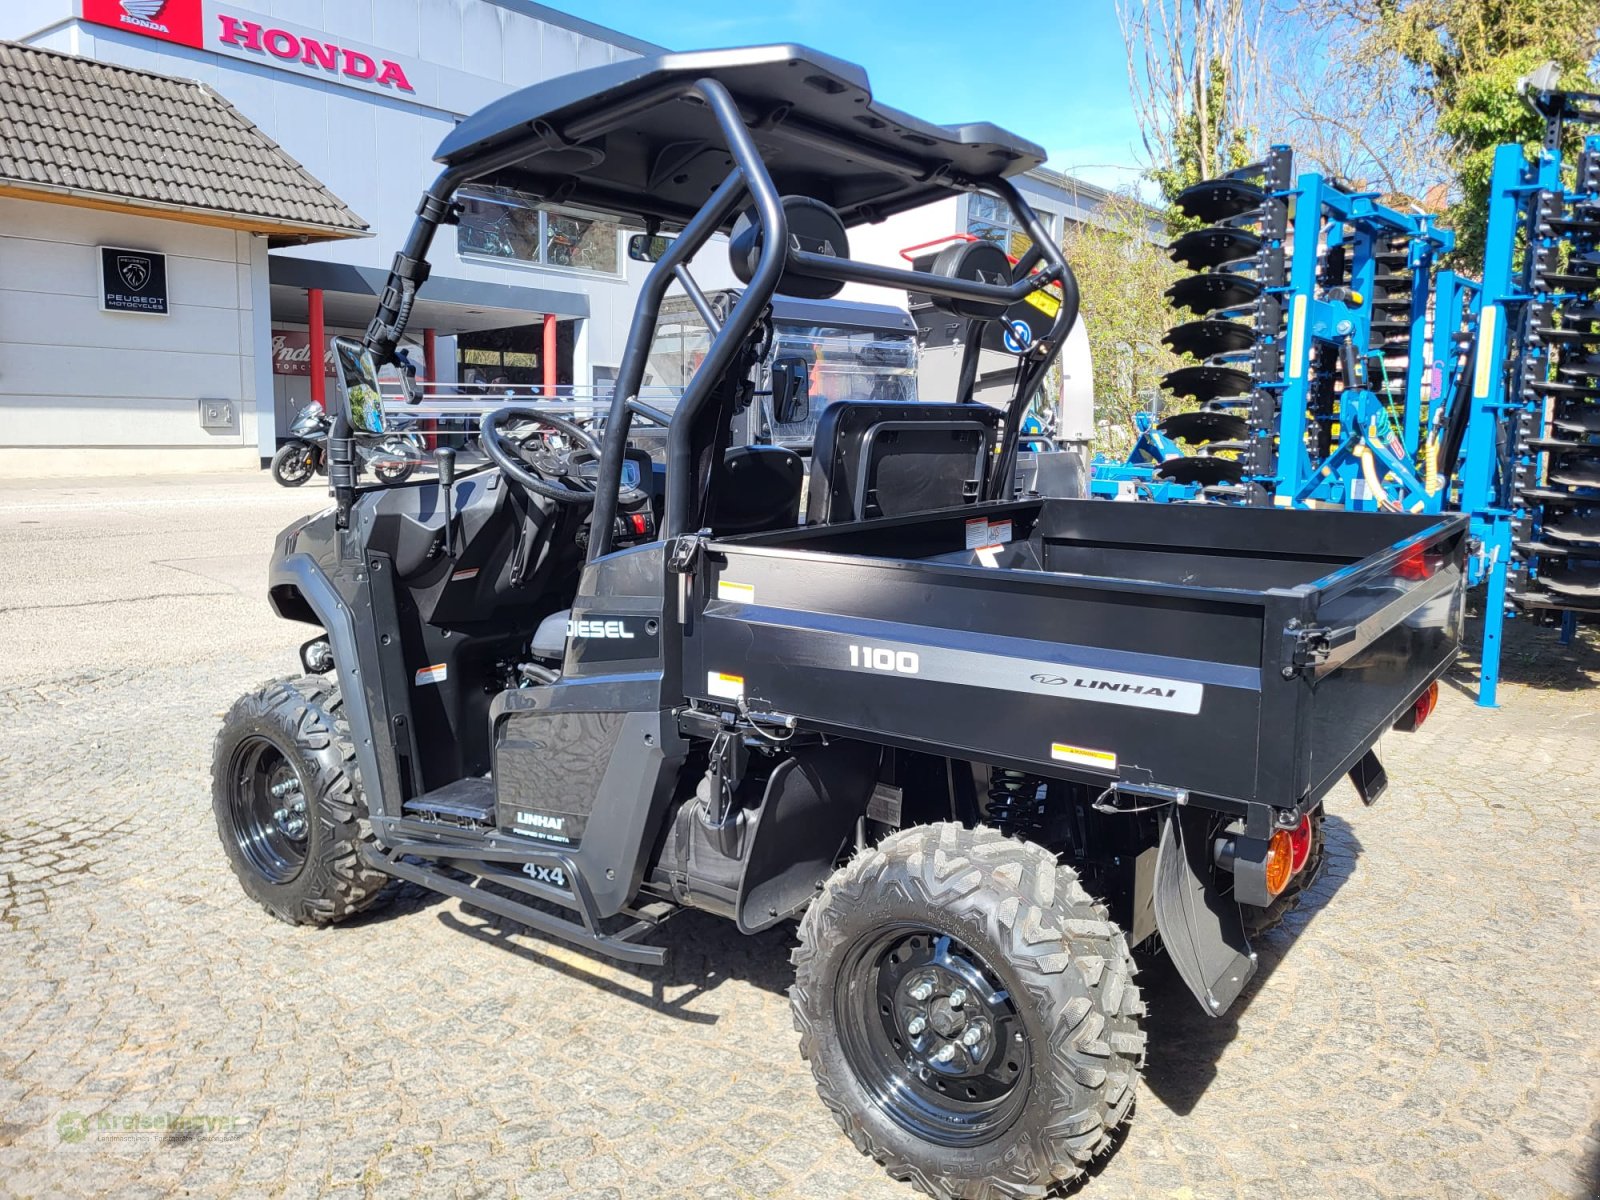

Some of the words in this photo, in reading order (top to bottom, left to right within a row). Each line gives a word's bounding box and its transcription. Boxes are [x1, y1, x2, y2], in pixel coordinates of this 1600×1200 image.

[120, 14, 169, 33] HONDA
[217, 14, 413, 91] HONDA
[107, 294, 164, 304] PEUGEOT
[108, 301, 164, 310] MOTOCYCLES
[567, 620, 634, 638] DIESEL
[849, 645, 919, 674] 1100
[1073, 678, 1177, 699] LINHAI
[517, 811, 563, 830] LINHAI
[522, 862, 565, 886] 4x4
